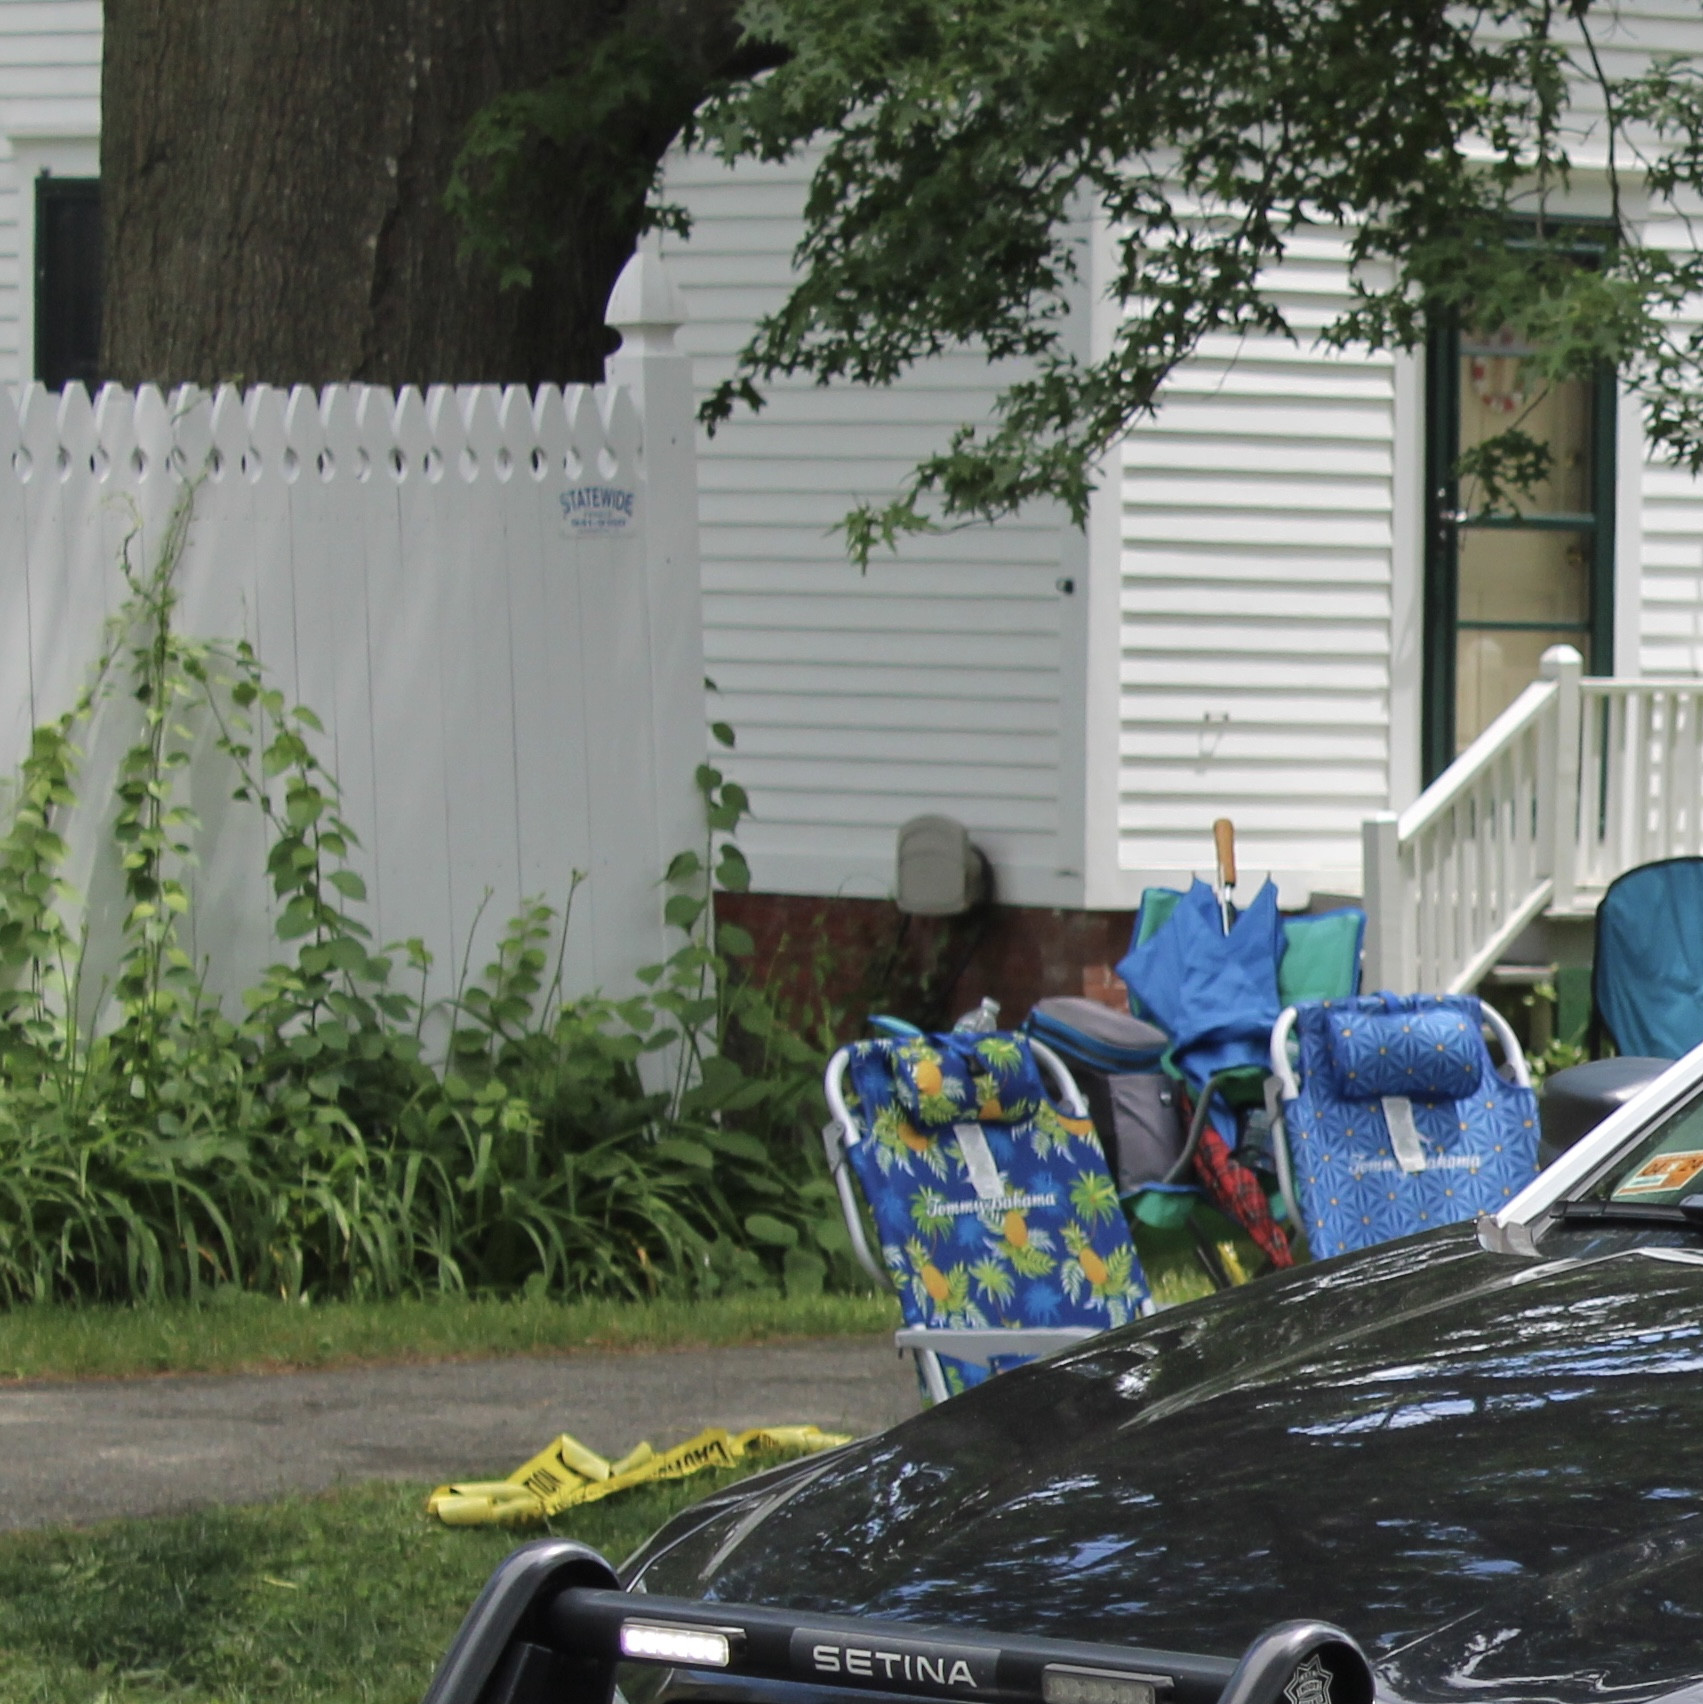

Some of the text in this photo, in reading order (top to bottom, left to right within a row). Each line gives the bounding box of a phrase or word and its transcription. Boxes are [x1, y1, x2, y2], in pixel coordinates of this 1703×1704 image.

[559, 486, 634, 518] STATEWIDE
[1349, 1152, 1481, 1178] Tomm ahama
[926, 1187, 1056, 1219] Tommy Bahama
[812, 1645, 978, 1688] SETINA
